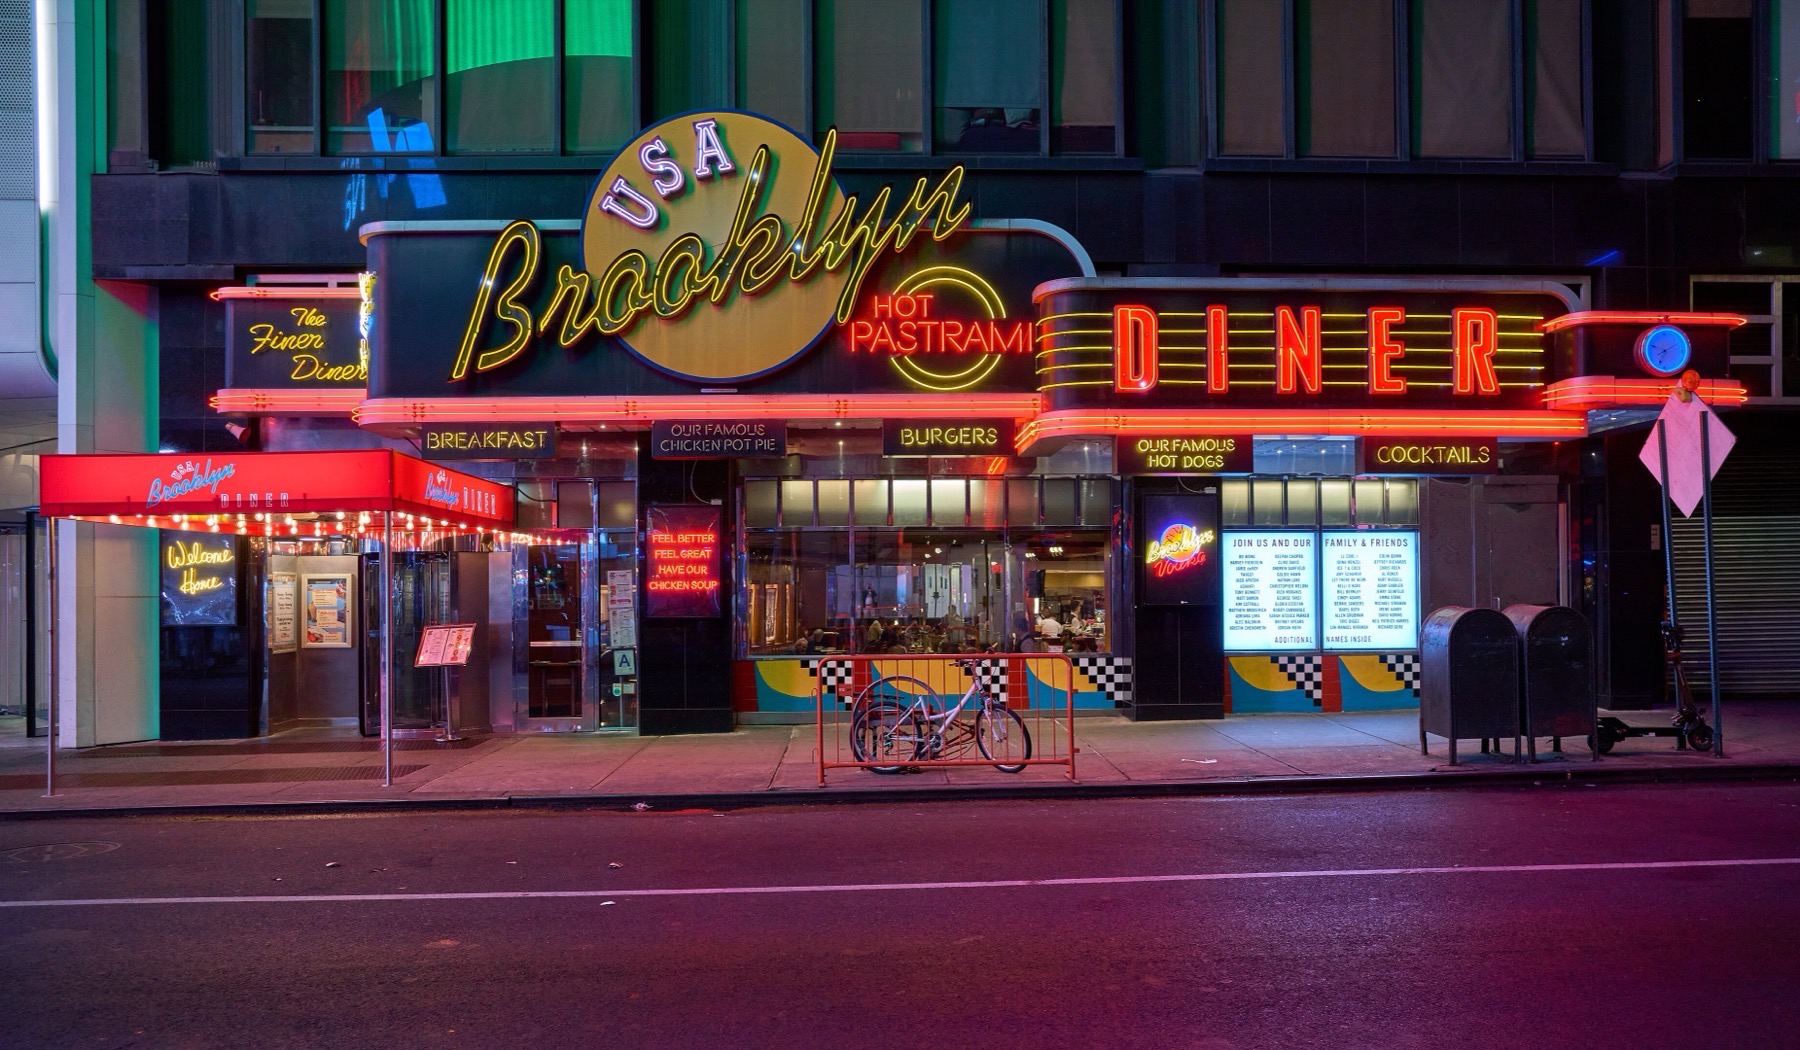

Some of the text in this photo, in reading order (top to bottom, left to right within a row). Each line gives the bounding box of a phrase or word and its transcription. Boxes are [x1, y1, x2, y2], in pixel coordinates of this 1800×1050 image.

[598, 117, 736, 229] USA
[448, 125, 973, 384] Brooklyn
[873, 295, 934, 318] HOT
[290, 307, 328, 327] The
[249, 324, 325, 355] Finer
[851, 321, 1034, 354] PASTRAMI
[1113, 304, 1501, 395] DINER
[291, 354, 368, 381] Diner
[427, 430, 548, 449] BREAKFAST
[670, 424, 765, 438] OUR FAMOUS
[900, 427, 998, 446] BURGERS
[660, 438, 776, 453] CHICKEN POT PIE
[1137, 439, 1235, 453] OUR FAMOUS
[1147, 454, 1224, 469] HOT DOGS
[1377, 446, 1490, 465] COCKTAILS
[170, 461, 195, 480] USA
[146, 458, 236, 508] Brooklyn
[220, 492, 289, 508] DINER
[463, 486, 496, 515] DINER
[652, 534, 715, 543] FEEL BETTER
[1233, 539, 1311, 548] JOIN US AND OUR
[1324, 538, 1408, 547] FAMILY & FRIENDS
[168, 540, 235, 569] Welcome
[654, 550, 712, 559] FEEL GREAT
[658, 565, 708, 575] HAVE OUR
[179, 567, 224, 595] Home
[649, 580, 718, 590] CHICKEN SOUP
[619, 654, 630, 667] A
